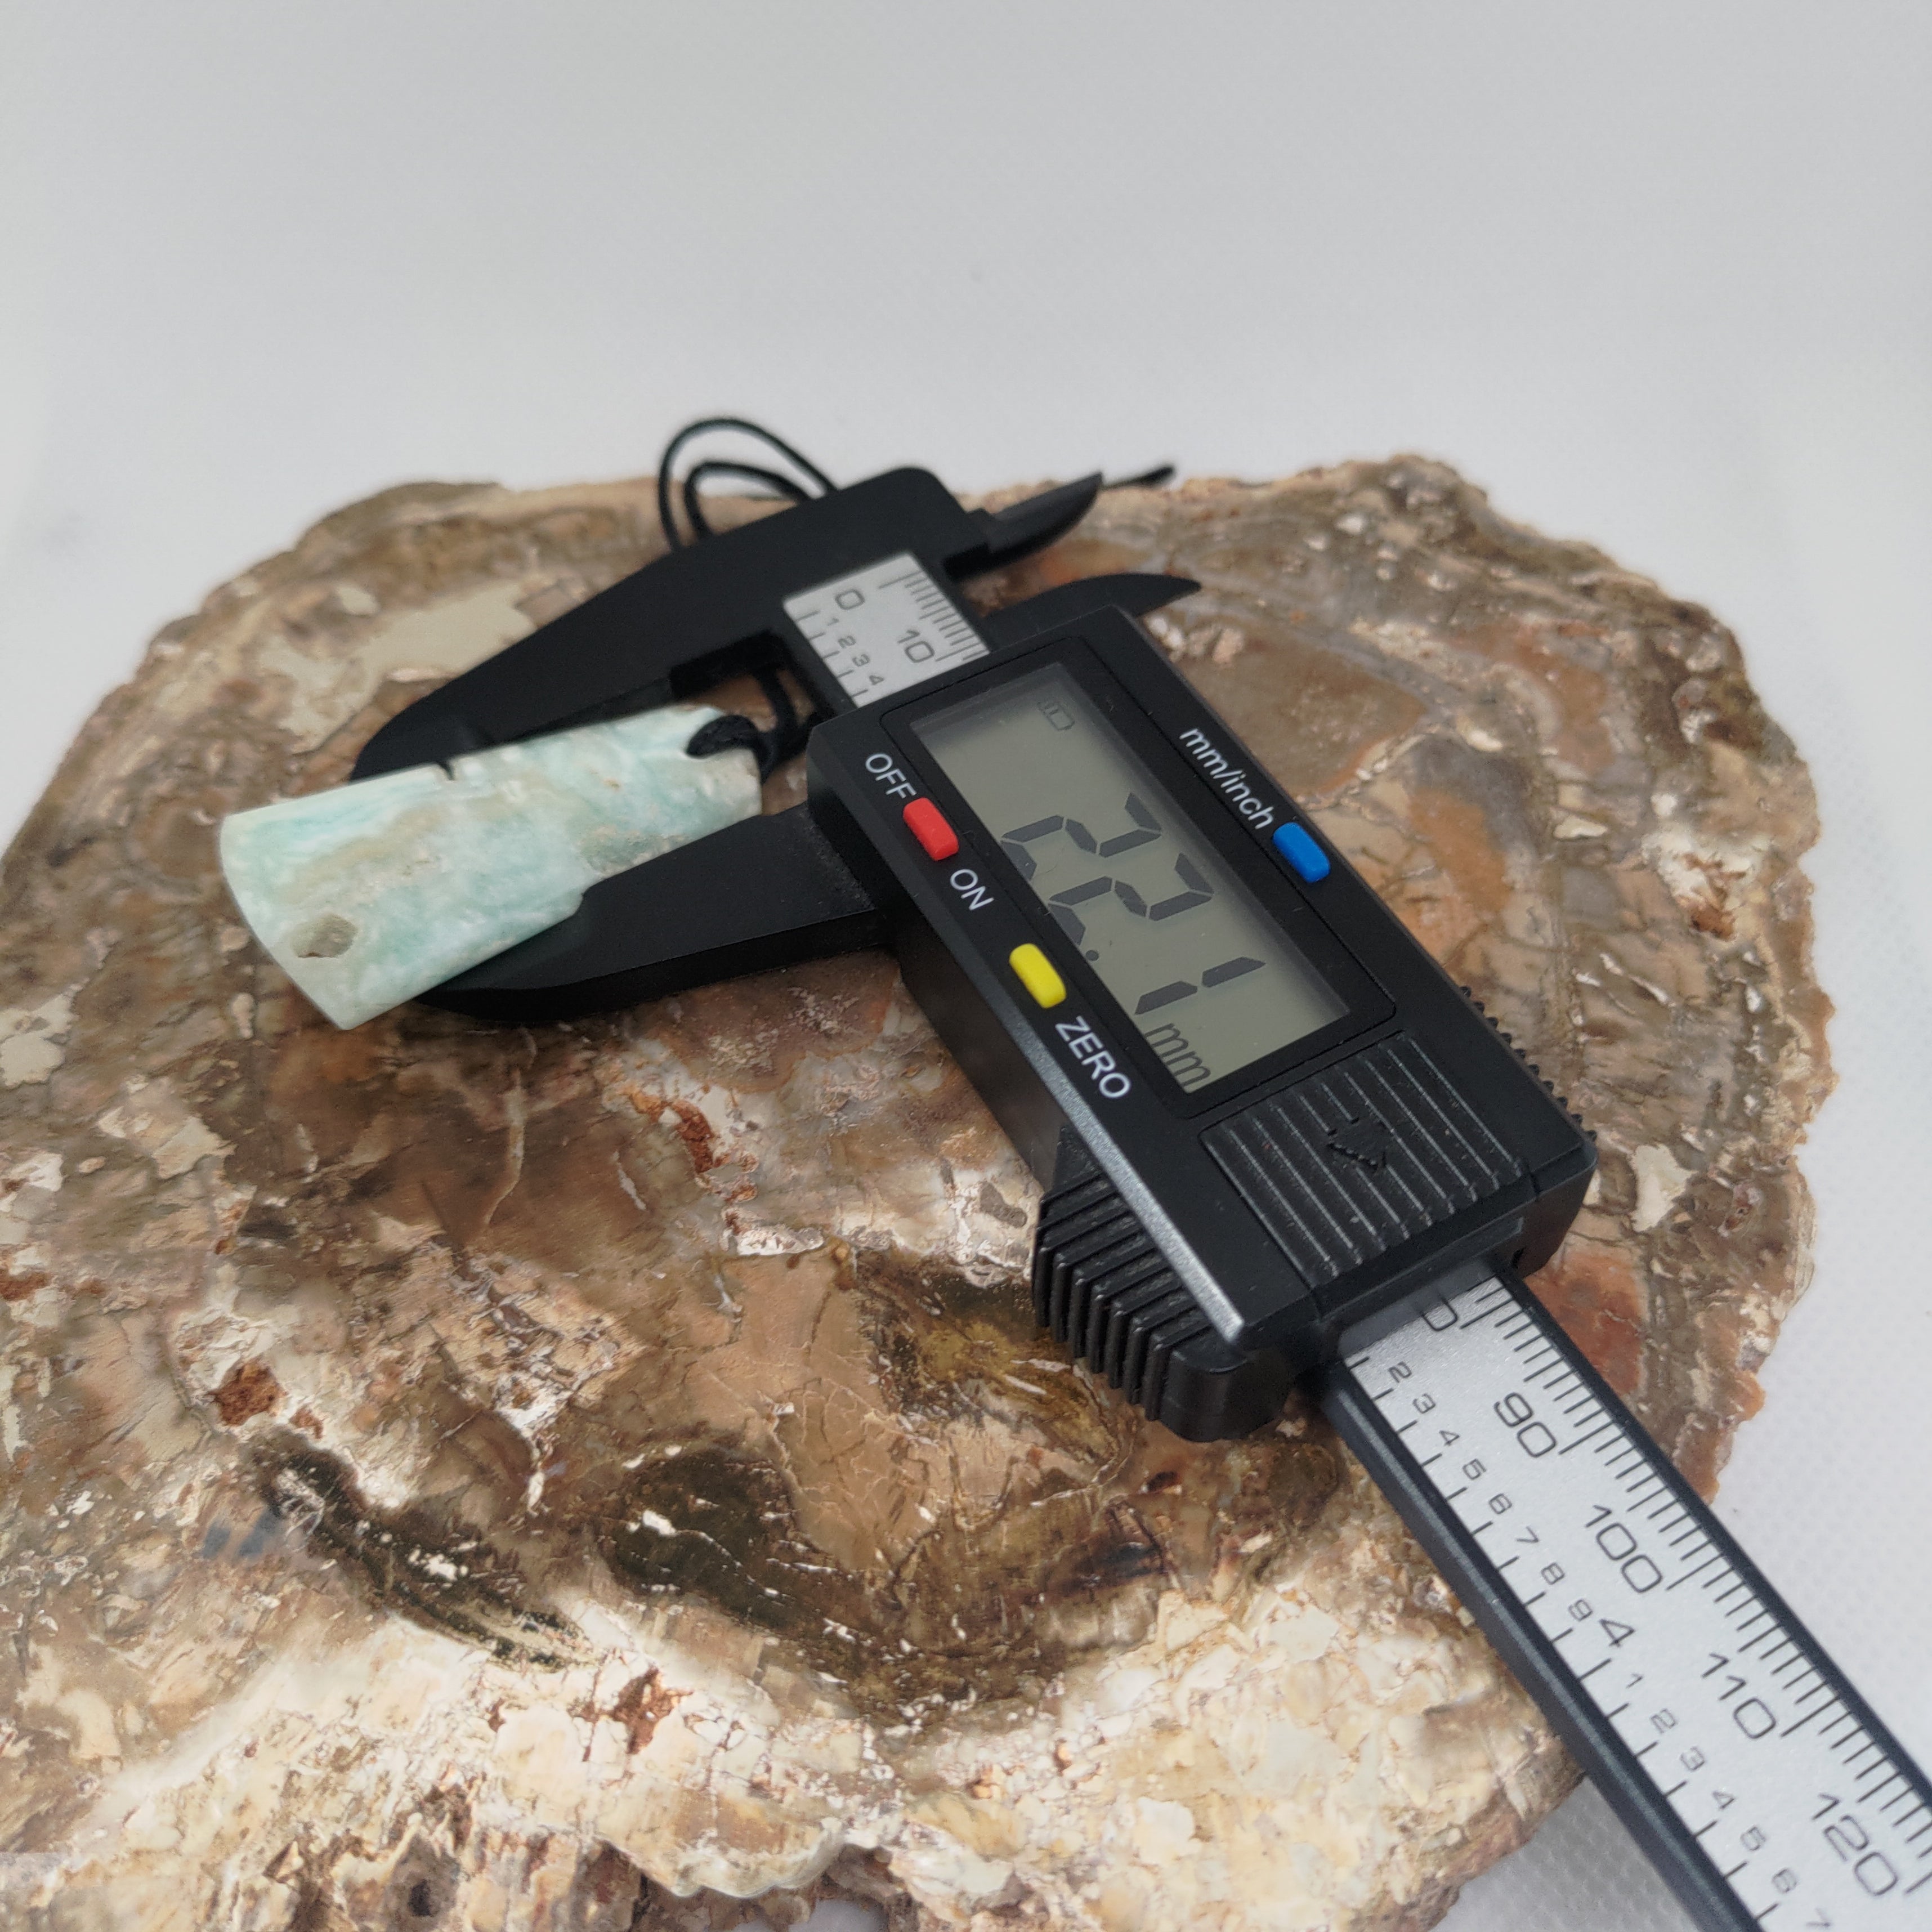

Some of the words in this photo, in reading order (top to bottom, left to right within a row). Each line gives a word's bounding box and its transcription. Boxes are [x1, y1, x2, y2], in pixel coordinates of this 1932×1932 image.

[837, 635, 856, 649] 2
[897, 629, 935, 664] 10
[852, 653, 871, 667] 3
[867, 674, 885, 686] 4
[865, 753, 918, 799] OFF
[1179, 728, 1274, 830] mm/inch
[950, 869, 995, 911] ON
[1054, 1015, 1132, 1098] ZERO
[1144, 1022, 1212, 1090] mm
[1387, 1361, 1413, 1383] 2
[1412, 1392, 1437, 1415] 3
[1438, 1429, 1461, 1447] 4
[1493, 1392, 1558, 1458] 90
[1461, 1458, 1487, 1481] 5
[1487, 1493, 1513, 1515] 6
[1515, 1526, 1540, 1544] 7
[1585, 1504, 1663, 1594] 100
[1540, 1562, 1566, 1585] 8
[1568, 1599, 1594, 1622] 9
[1599, 1618, 1635, 1647] 4
[1626, 1672, 1644, 1689] 1
[1701, 1652, 1777, 1739] 110
[1649, 1708, 1678, 1734] 2
[1679, 1746, 1706, 1772] 3
[1711, 1790, 1736, 1810] 4
[1739, 1826, 1766, 1852] 5
[1811, 1792, 1899, 1897] 120
[1771, 1867, 1798, 1894] 6
